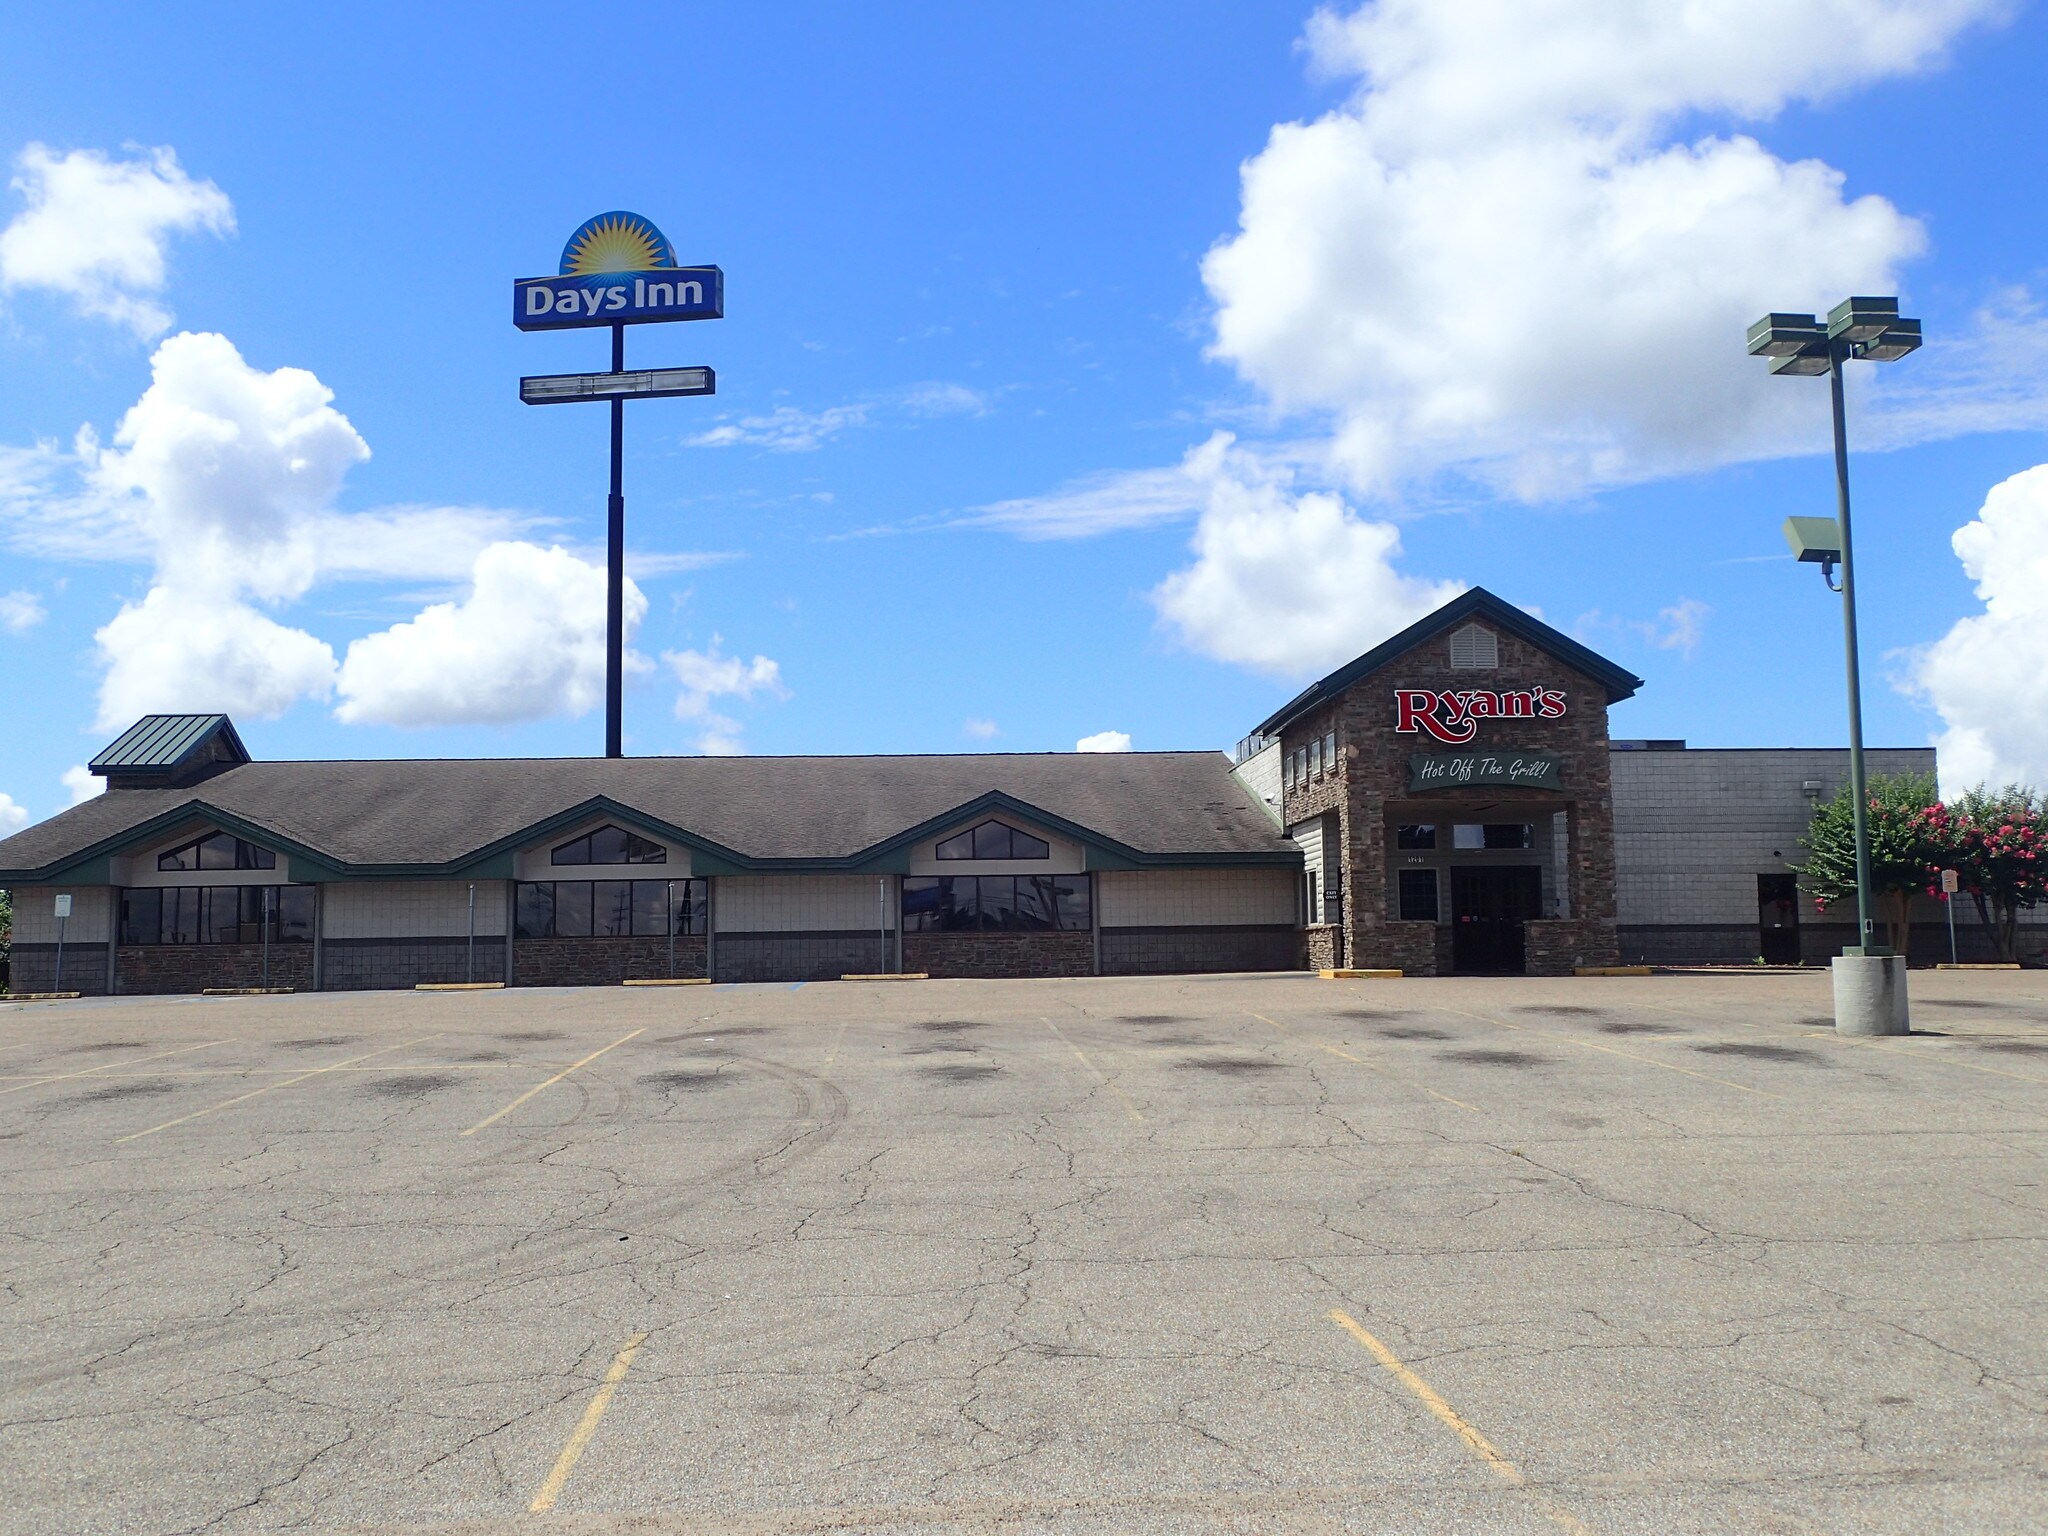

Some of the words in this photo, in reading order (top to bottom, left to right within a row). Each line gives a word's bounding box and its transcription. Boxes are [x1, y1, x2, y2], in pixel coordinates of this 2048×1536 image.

[526, 286, 627, 316] Days
[635, 279, 703, 308] Inn
[1394, 685, 1567, 744] Ryan's
[1421, 760, 1445, 779] Hot
[1449, 758, 1474, 781] Off
[1480, 757, 1503, 775] The
[1509, 759, 1550, 780] Grill!
